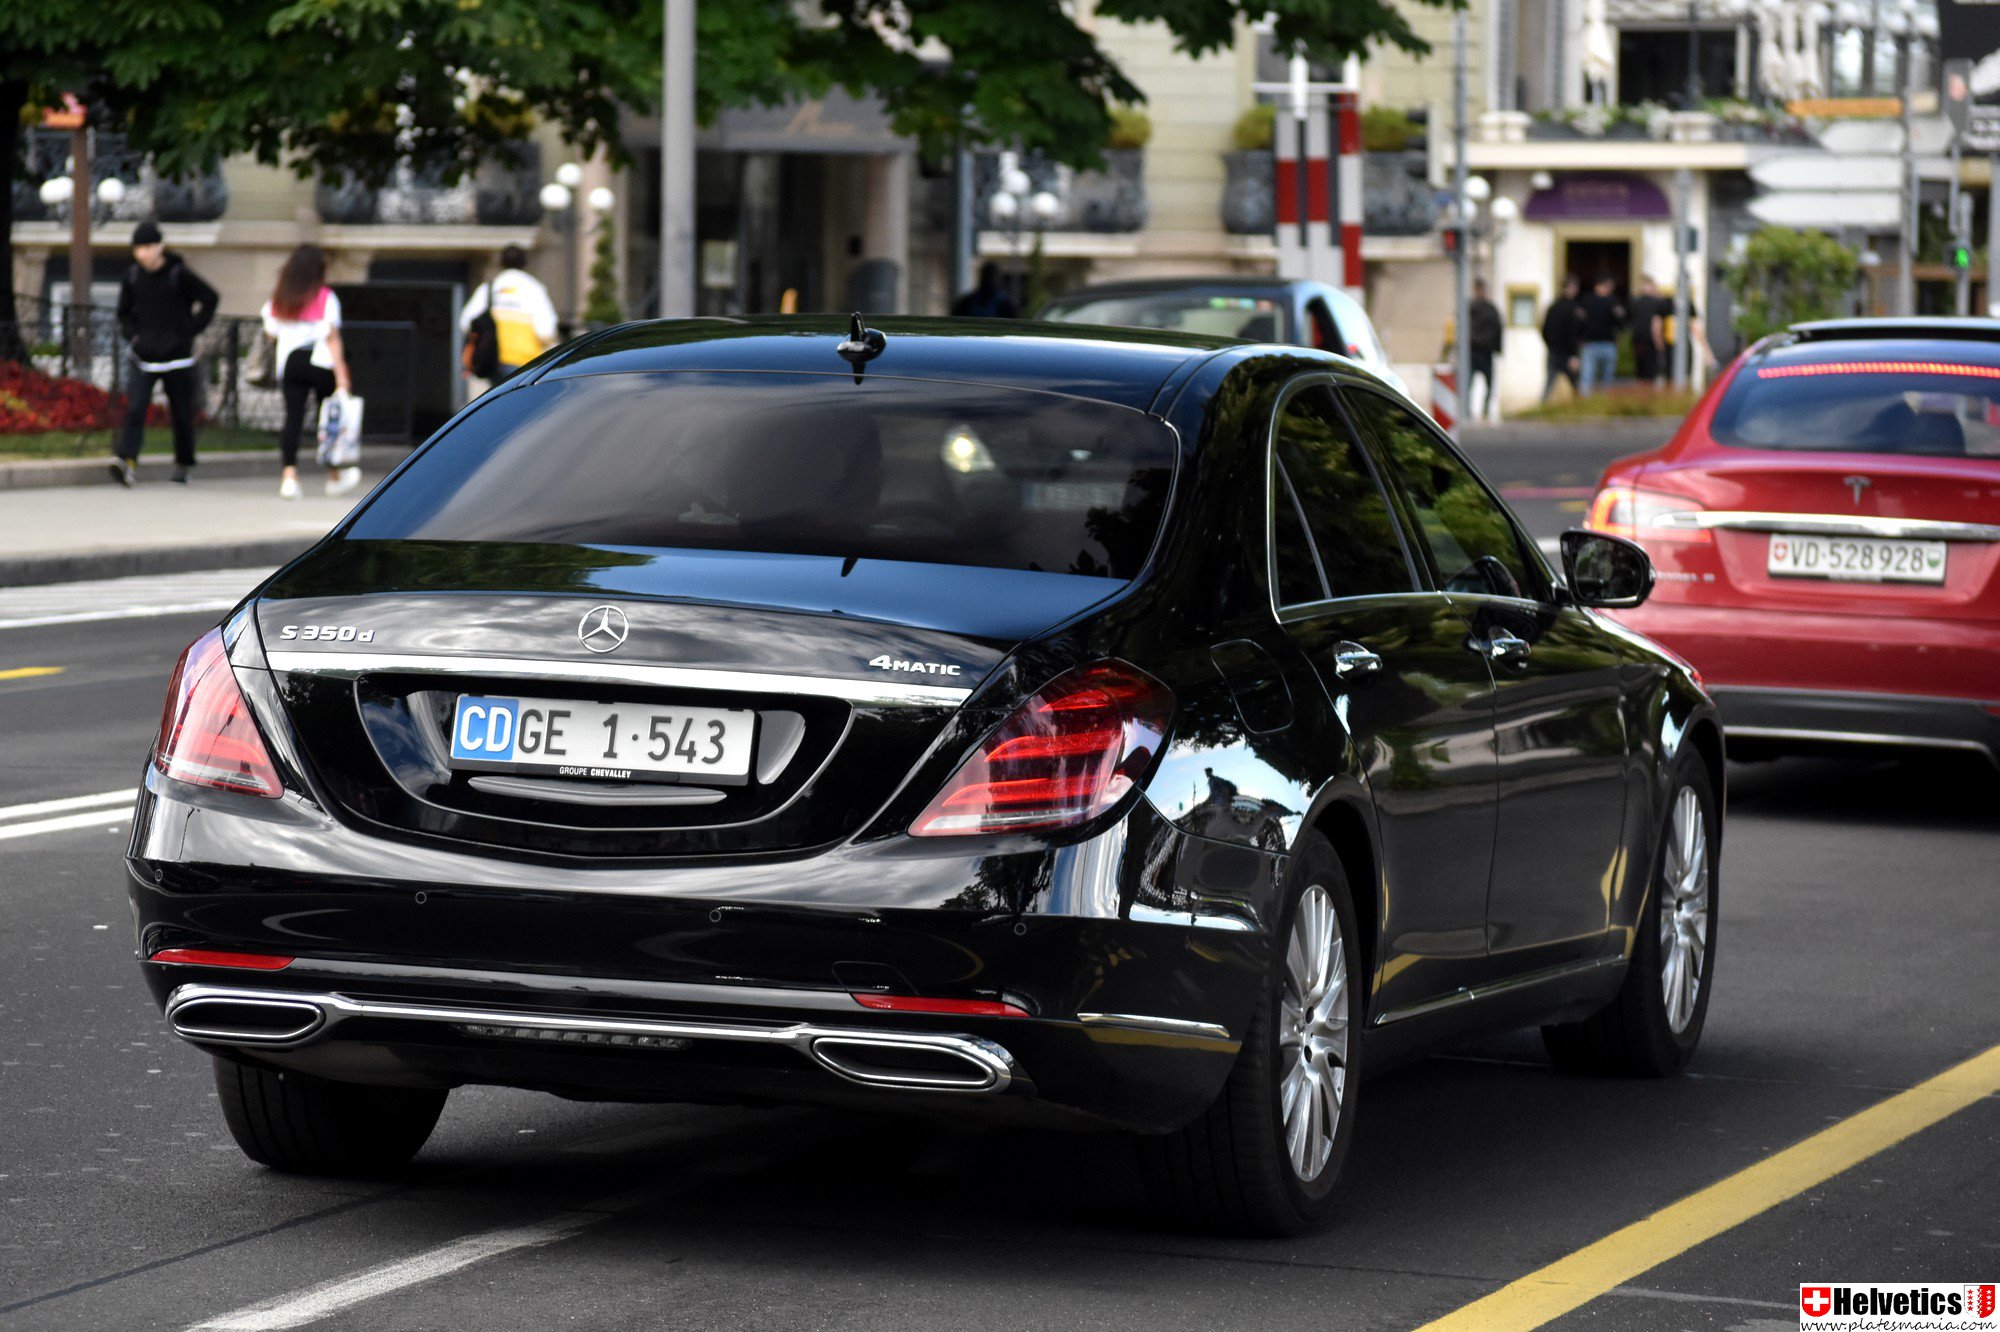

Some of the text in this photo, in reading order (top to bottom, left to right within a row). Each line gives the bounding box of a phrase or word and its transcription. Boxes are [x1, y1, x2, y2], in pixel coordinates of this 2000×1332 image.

[280, 625, 299, 640] S
[868, 654, 961, 676] 4MATIC
[459, 704, 513, 753] CD
[517, 708, 572, 756] GE
[559, 765, 632, 779] GROUPE CHEVALLEY
